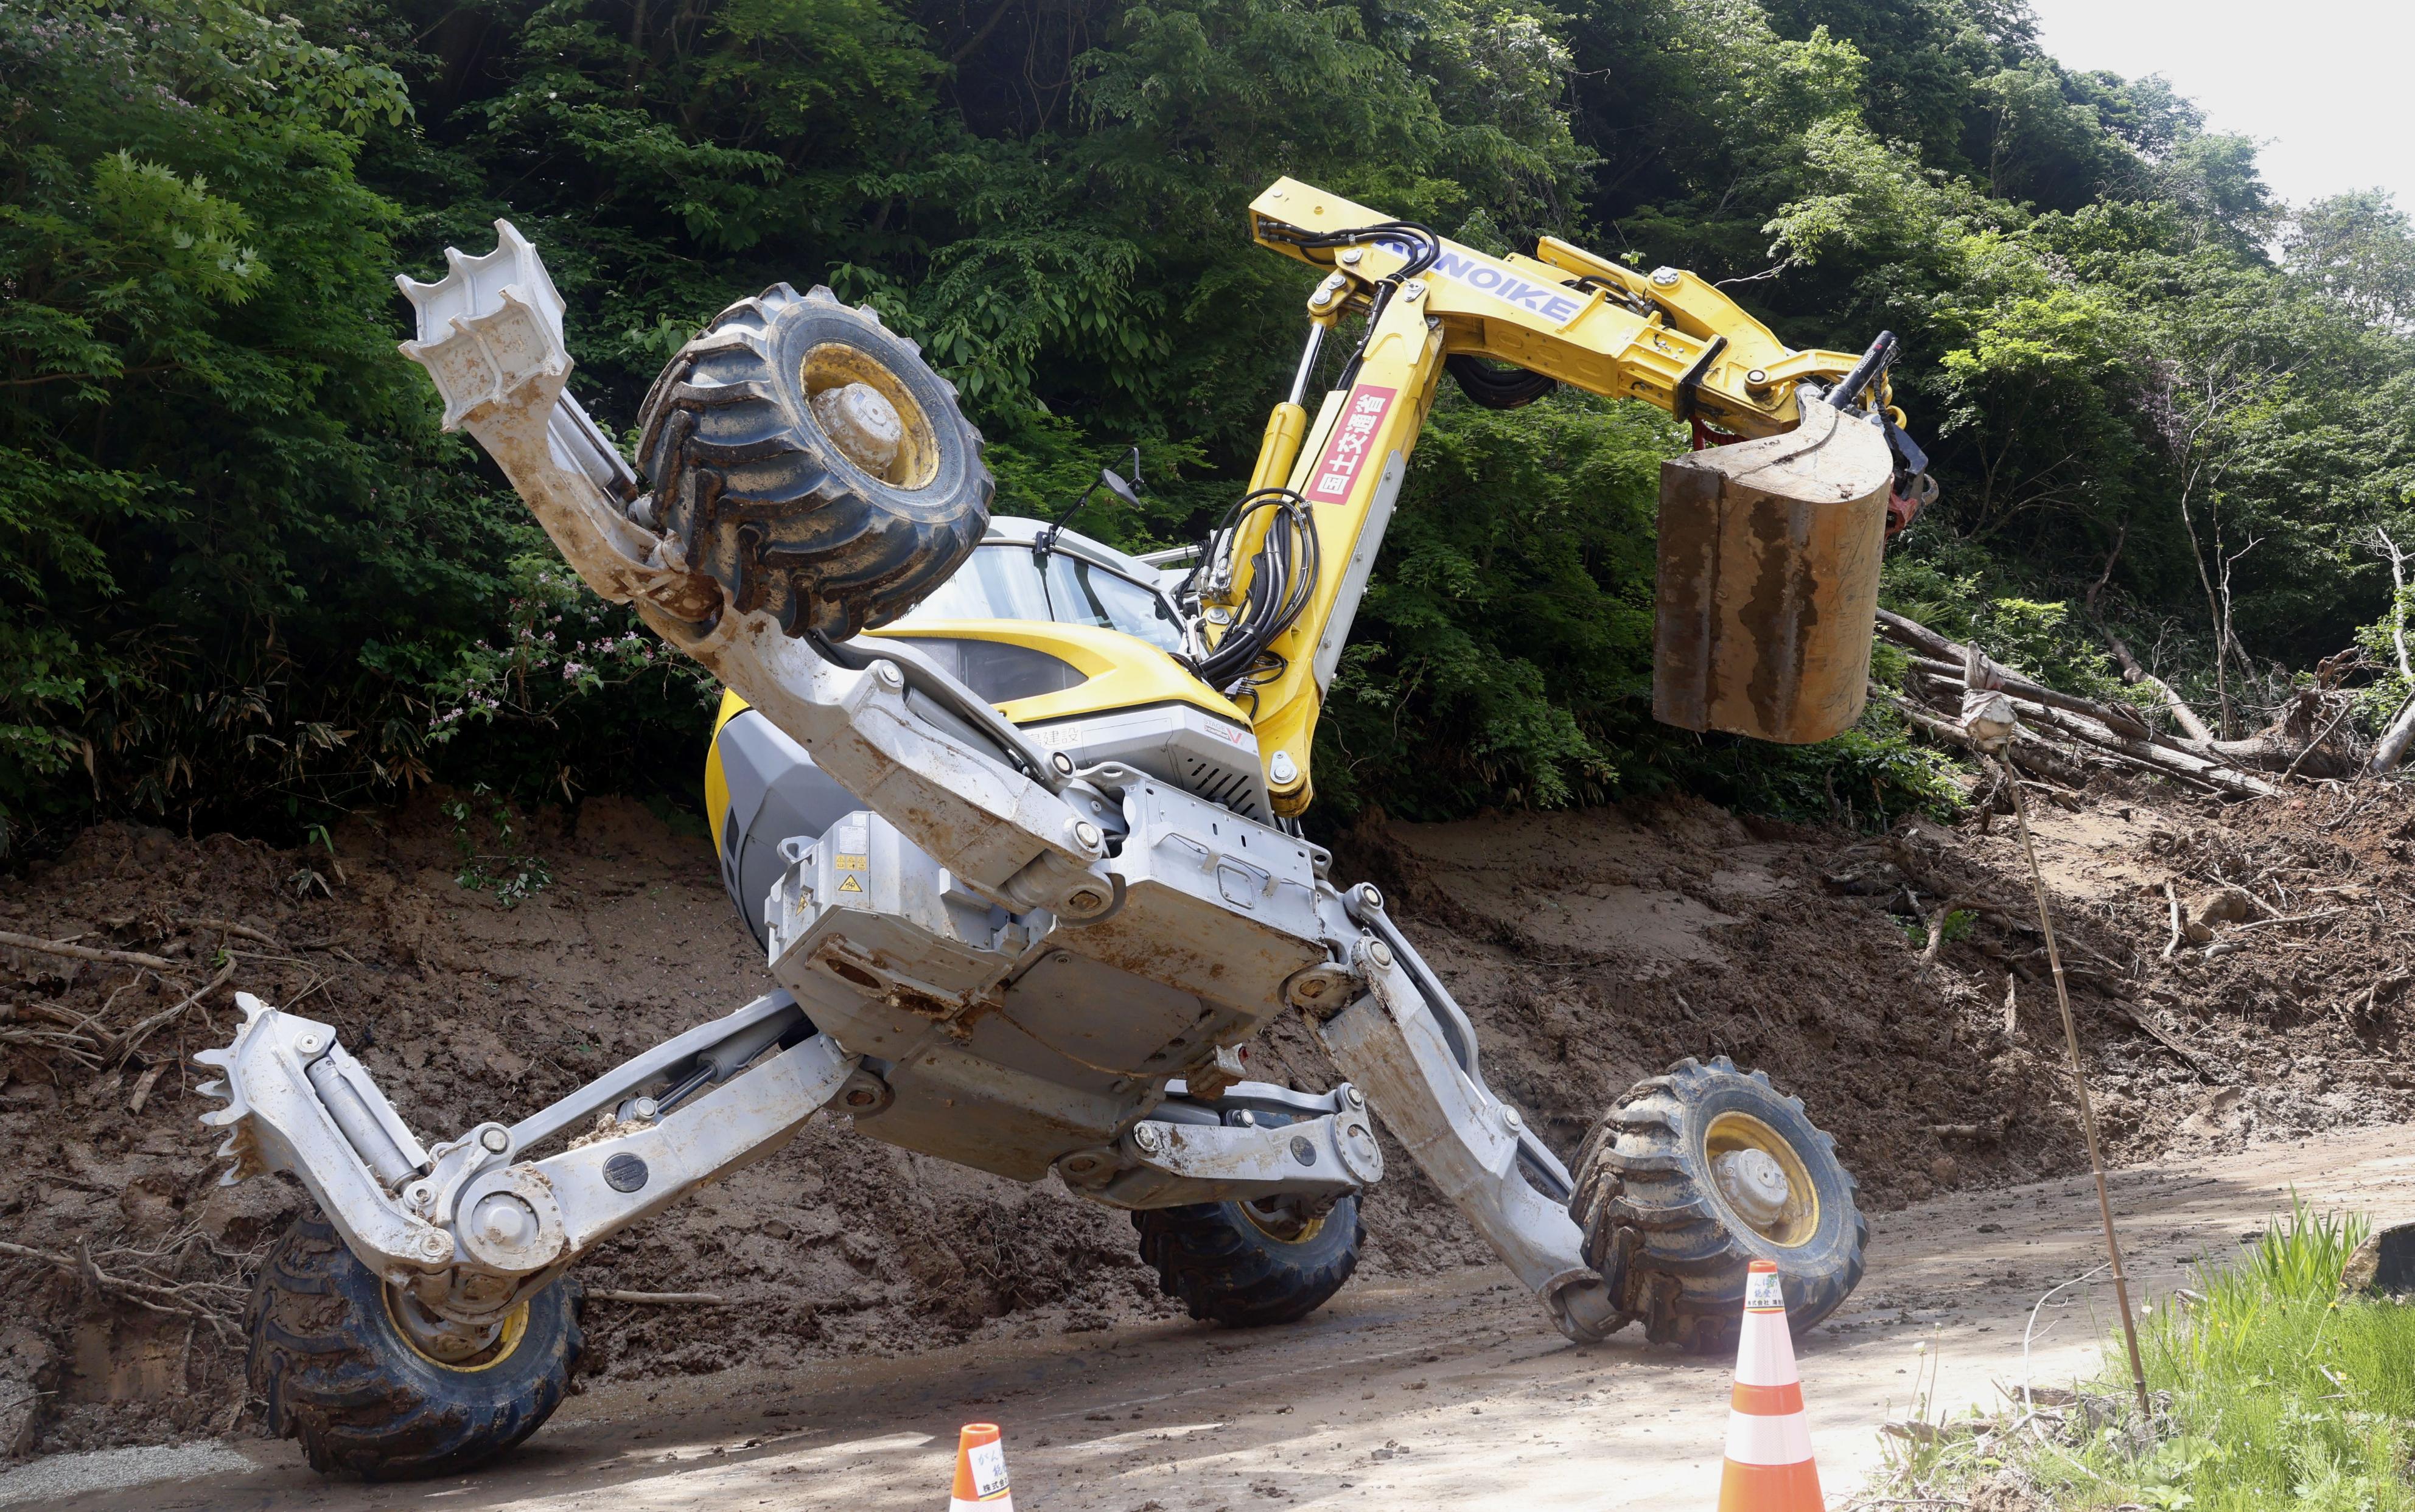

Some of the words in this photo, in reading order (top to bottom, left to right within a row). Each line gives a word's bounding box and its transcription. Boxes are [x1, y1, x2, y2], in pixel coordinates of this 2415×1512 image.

[1316, 394, 1386, 495] 国土交通省
[1203, 719, 1226, 731] STAGE
[1226, 728, 1243, 744] V
[978, 1449, 1003, 1466] がん
